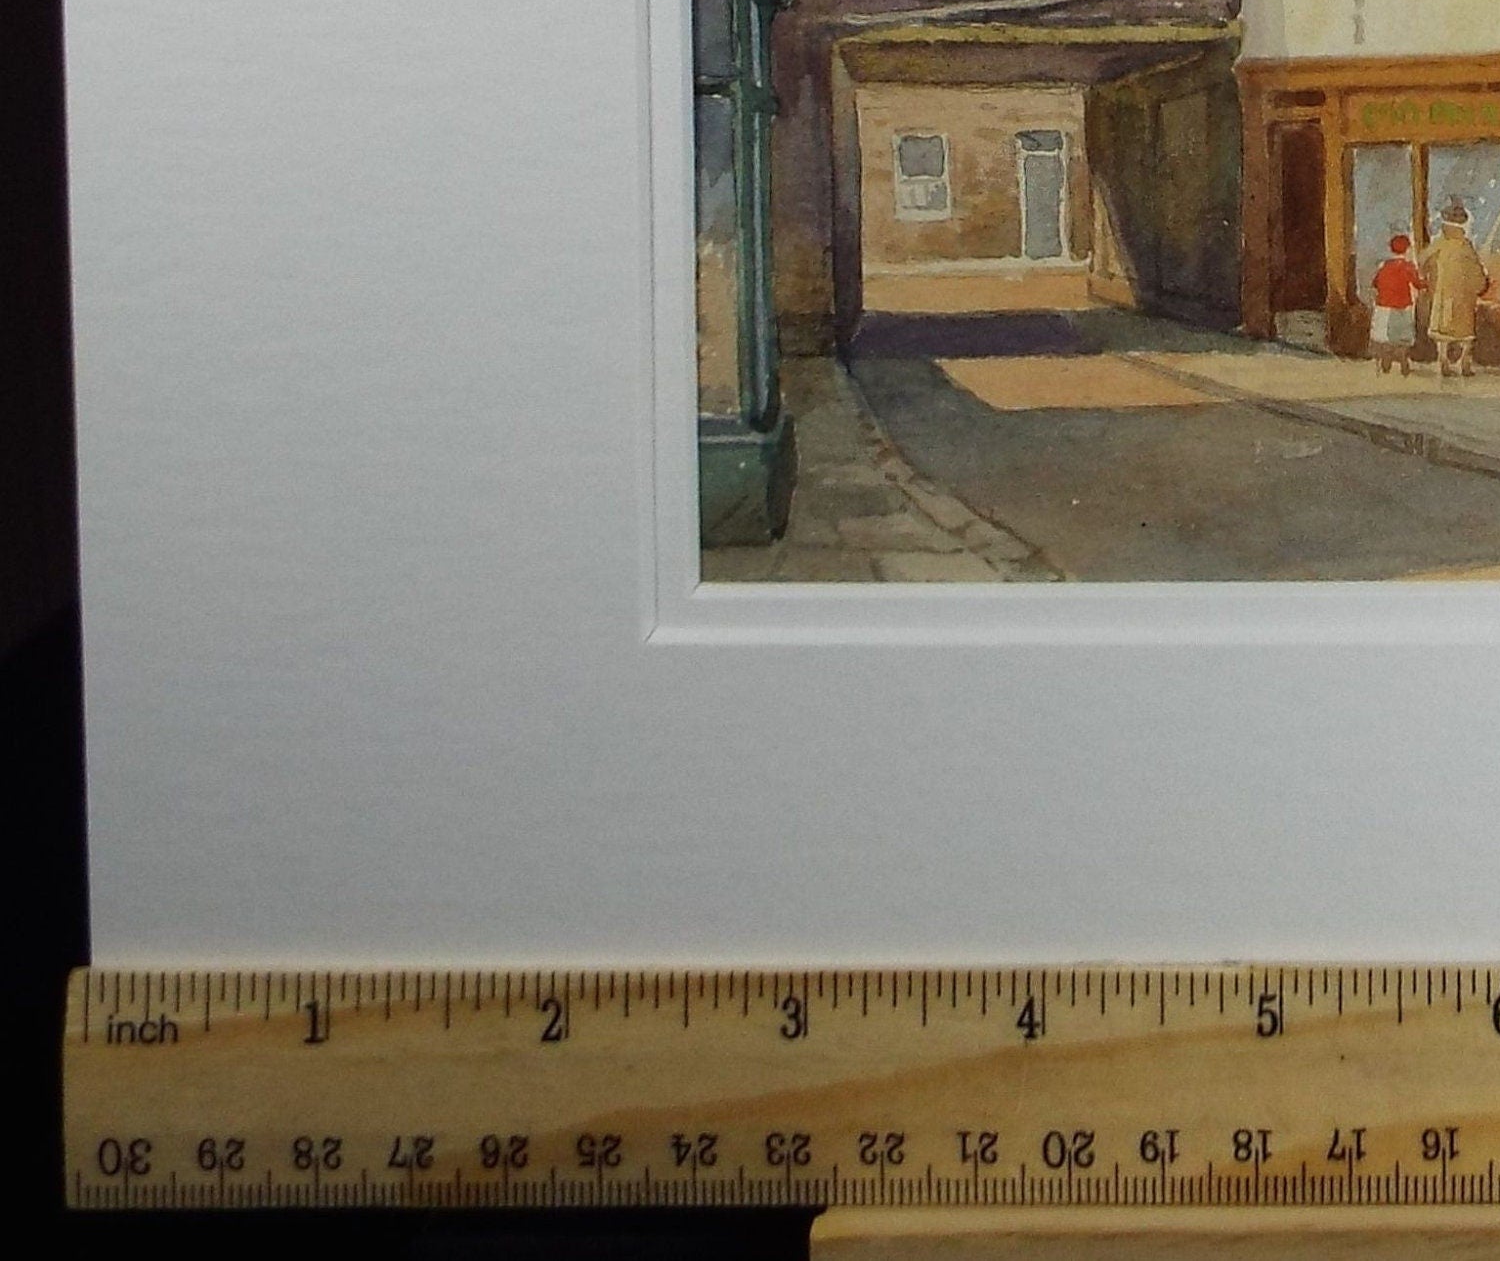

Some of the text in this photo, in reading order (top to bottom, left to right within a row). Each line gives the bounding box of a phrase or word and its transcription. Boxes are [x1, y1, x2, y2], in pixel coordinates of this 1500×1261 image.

[106, 1014, 179, 1044] inch
[303, 1000, 326, 1044] 1
[541, 1000, 565, 1042] 2
[780, 997, 802, 1038] 3
[1017, 995, 1040, 1038] 4
[1256, 994, 1279, 1038] 5
[98, 1139, 152, 1176] 30
[198, 1138, 246, 1171] 29
[293, 1137, 343, 1170] 28
[388, 1136, 435, 1170] 27
[480, 1136, 530, 1170] 26
[577, 1134, 623, 1168] 25
[671, 1133, 718, 1166] 24
[766, 1132, 812, 1166] 23
[858, 1132, 906, 1165] 22
[956, 1131, 999, 1164] 21
[1042, 1130, 1096, 1169] 20
[1139, 1129, 1180, 1164] 19
[1232, 1129, 1273, 1163] 18
[1327, 1128, 1367, 1162] 17
[1421, 1128, 1461, 1160] 16
